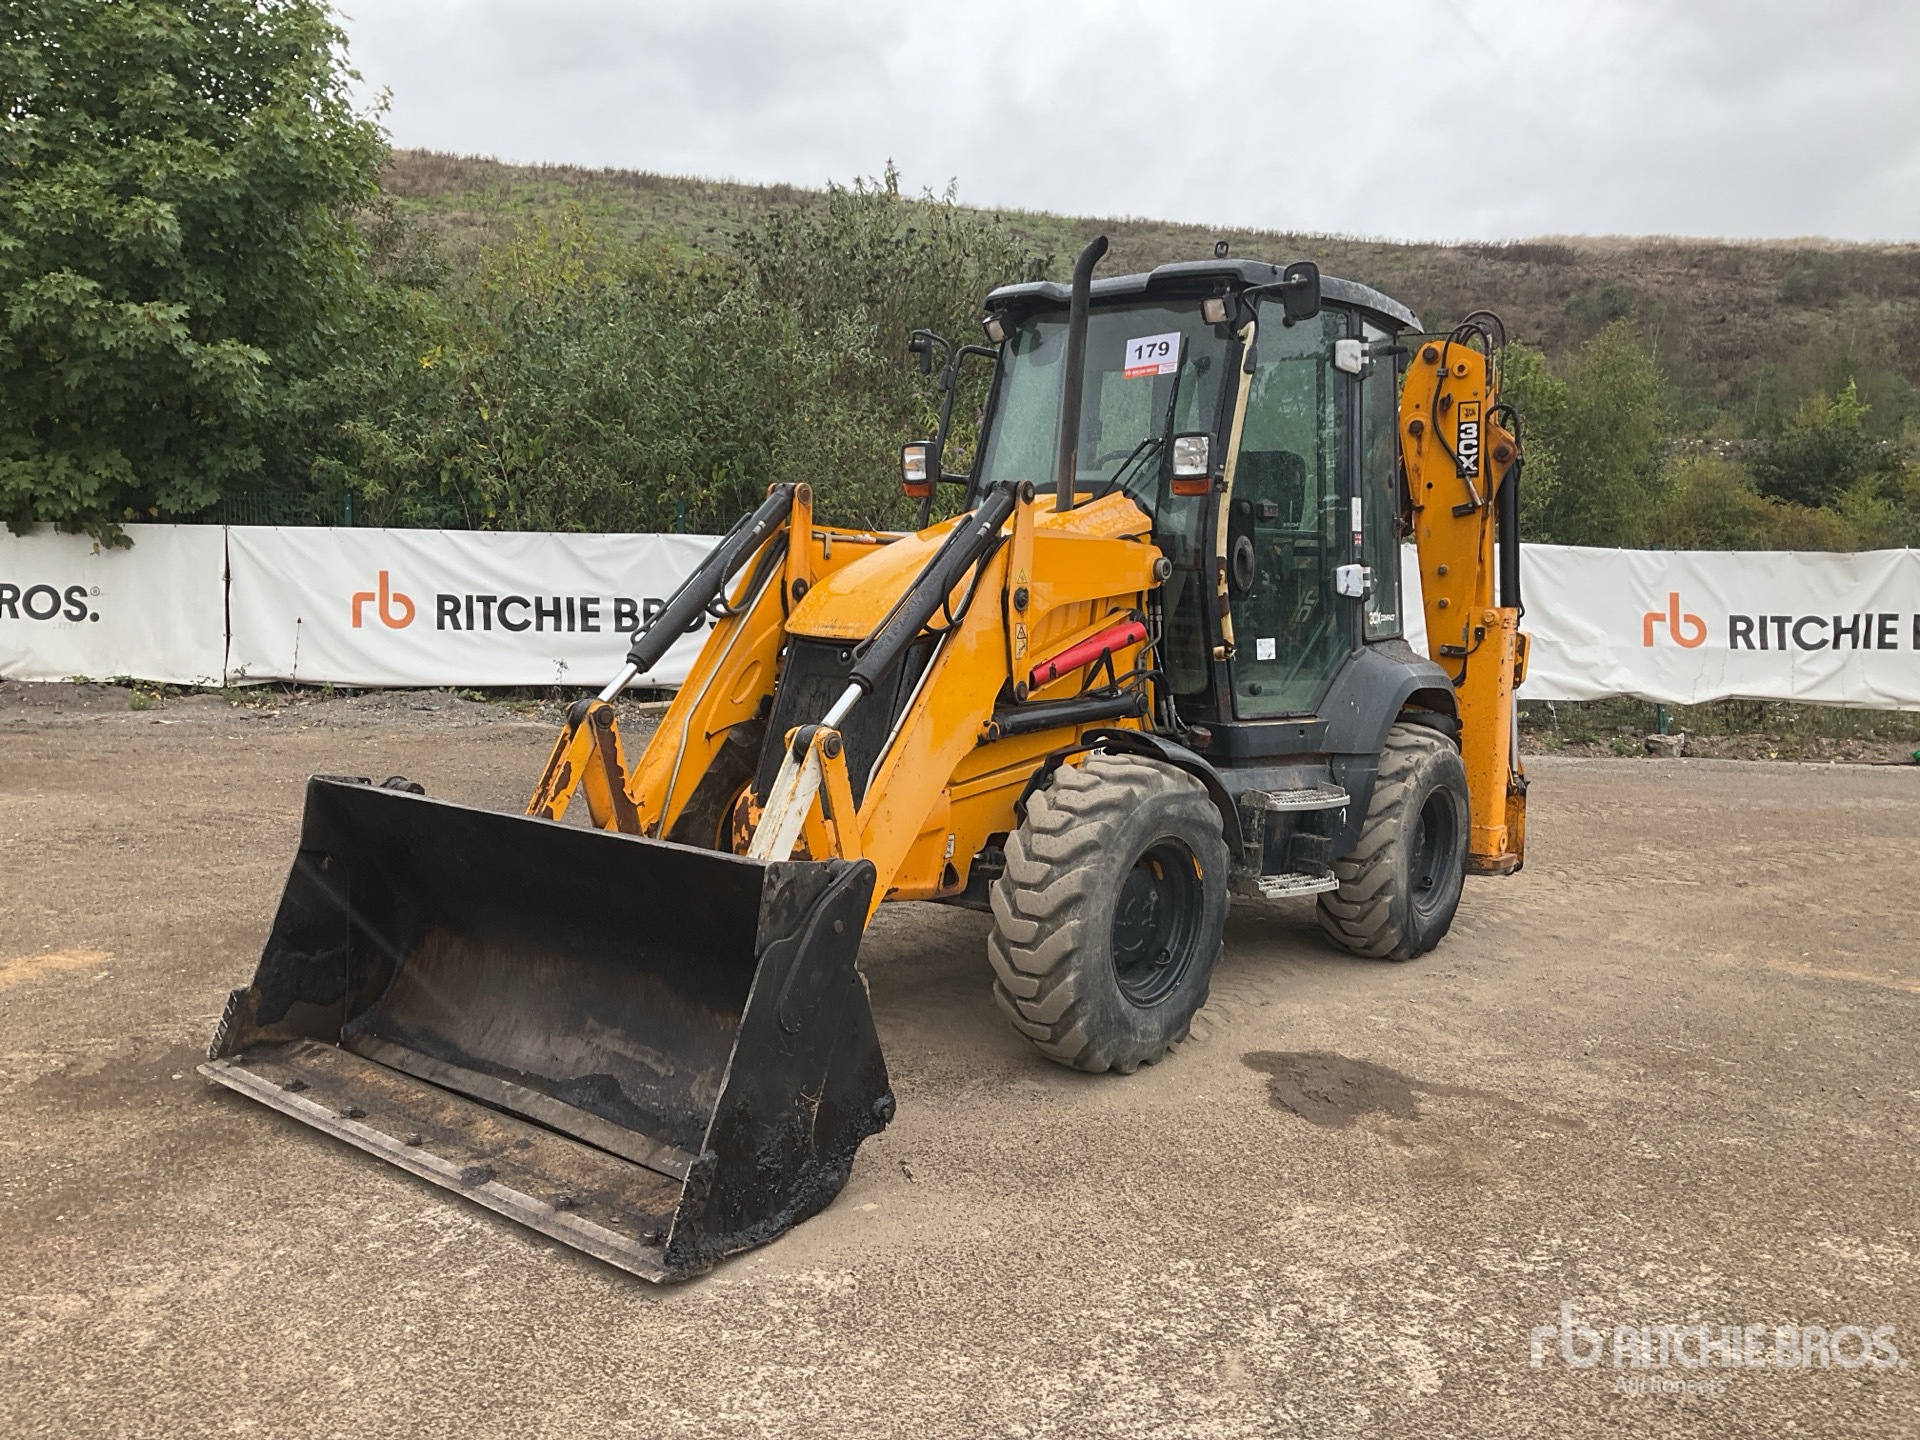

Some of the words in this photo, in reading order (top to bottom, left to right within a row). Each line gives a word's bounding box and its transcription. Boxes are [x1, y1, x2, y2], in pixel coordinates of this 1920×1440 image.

[1134, 341, 1170, 360] 179
[1458, 422, 1478, 471] 3CX
[436, 594, 601, 632] RITCHIE
[1729, 613, 1900, 651] RITCHIE
